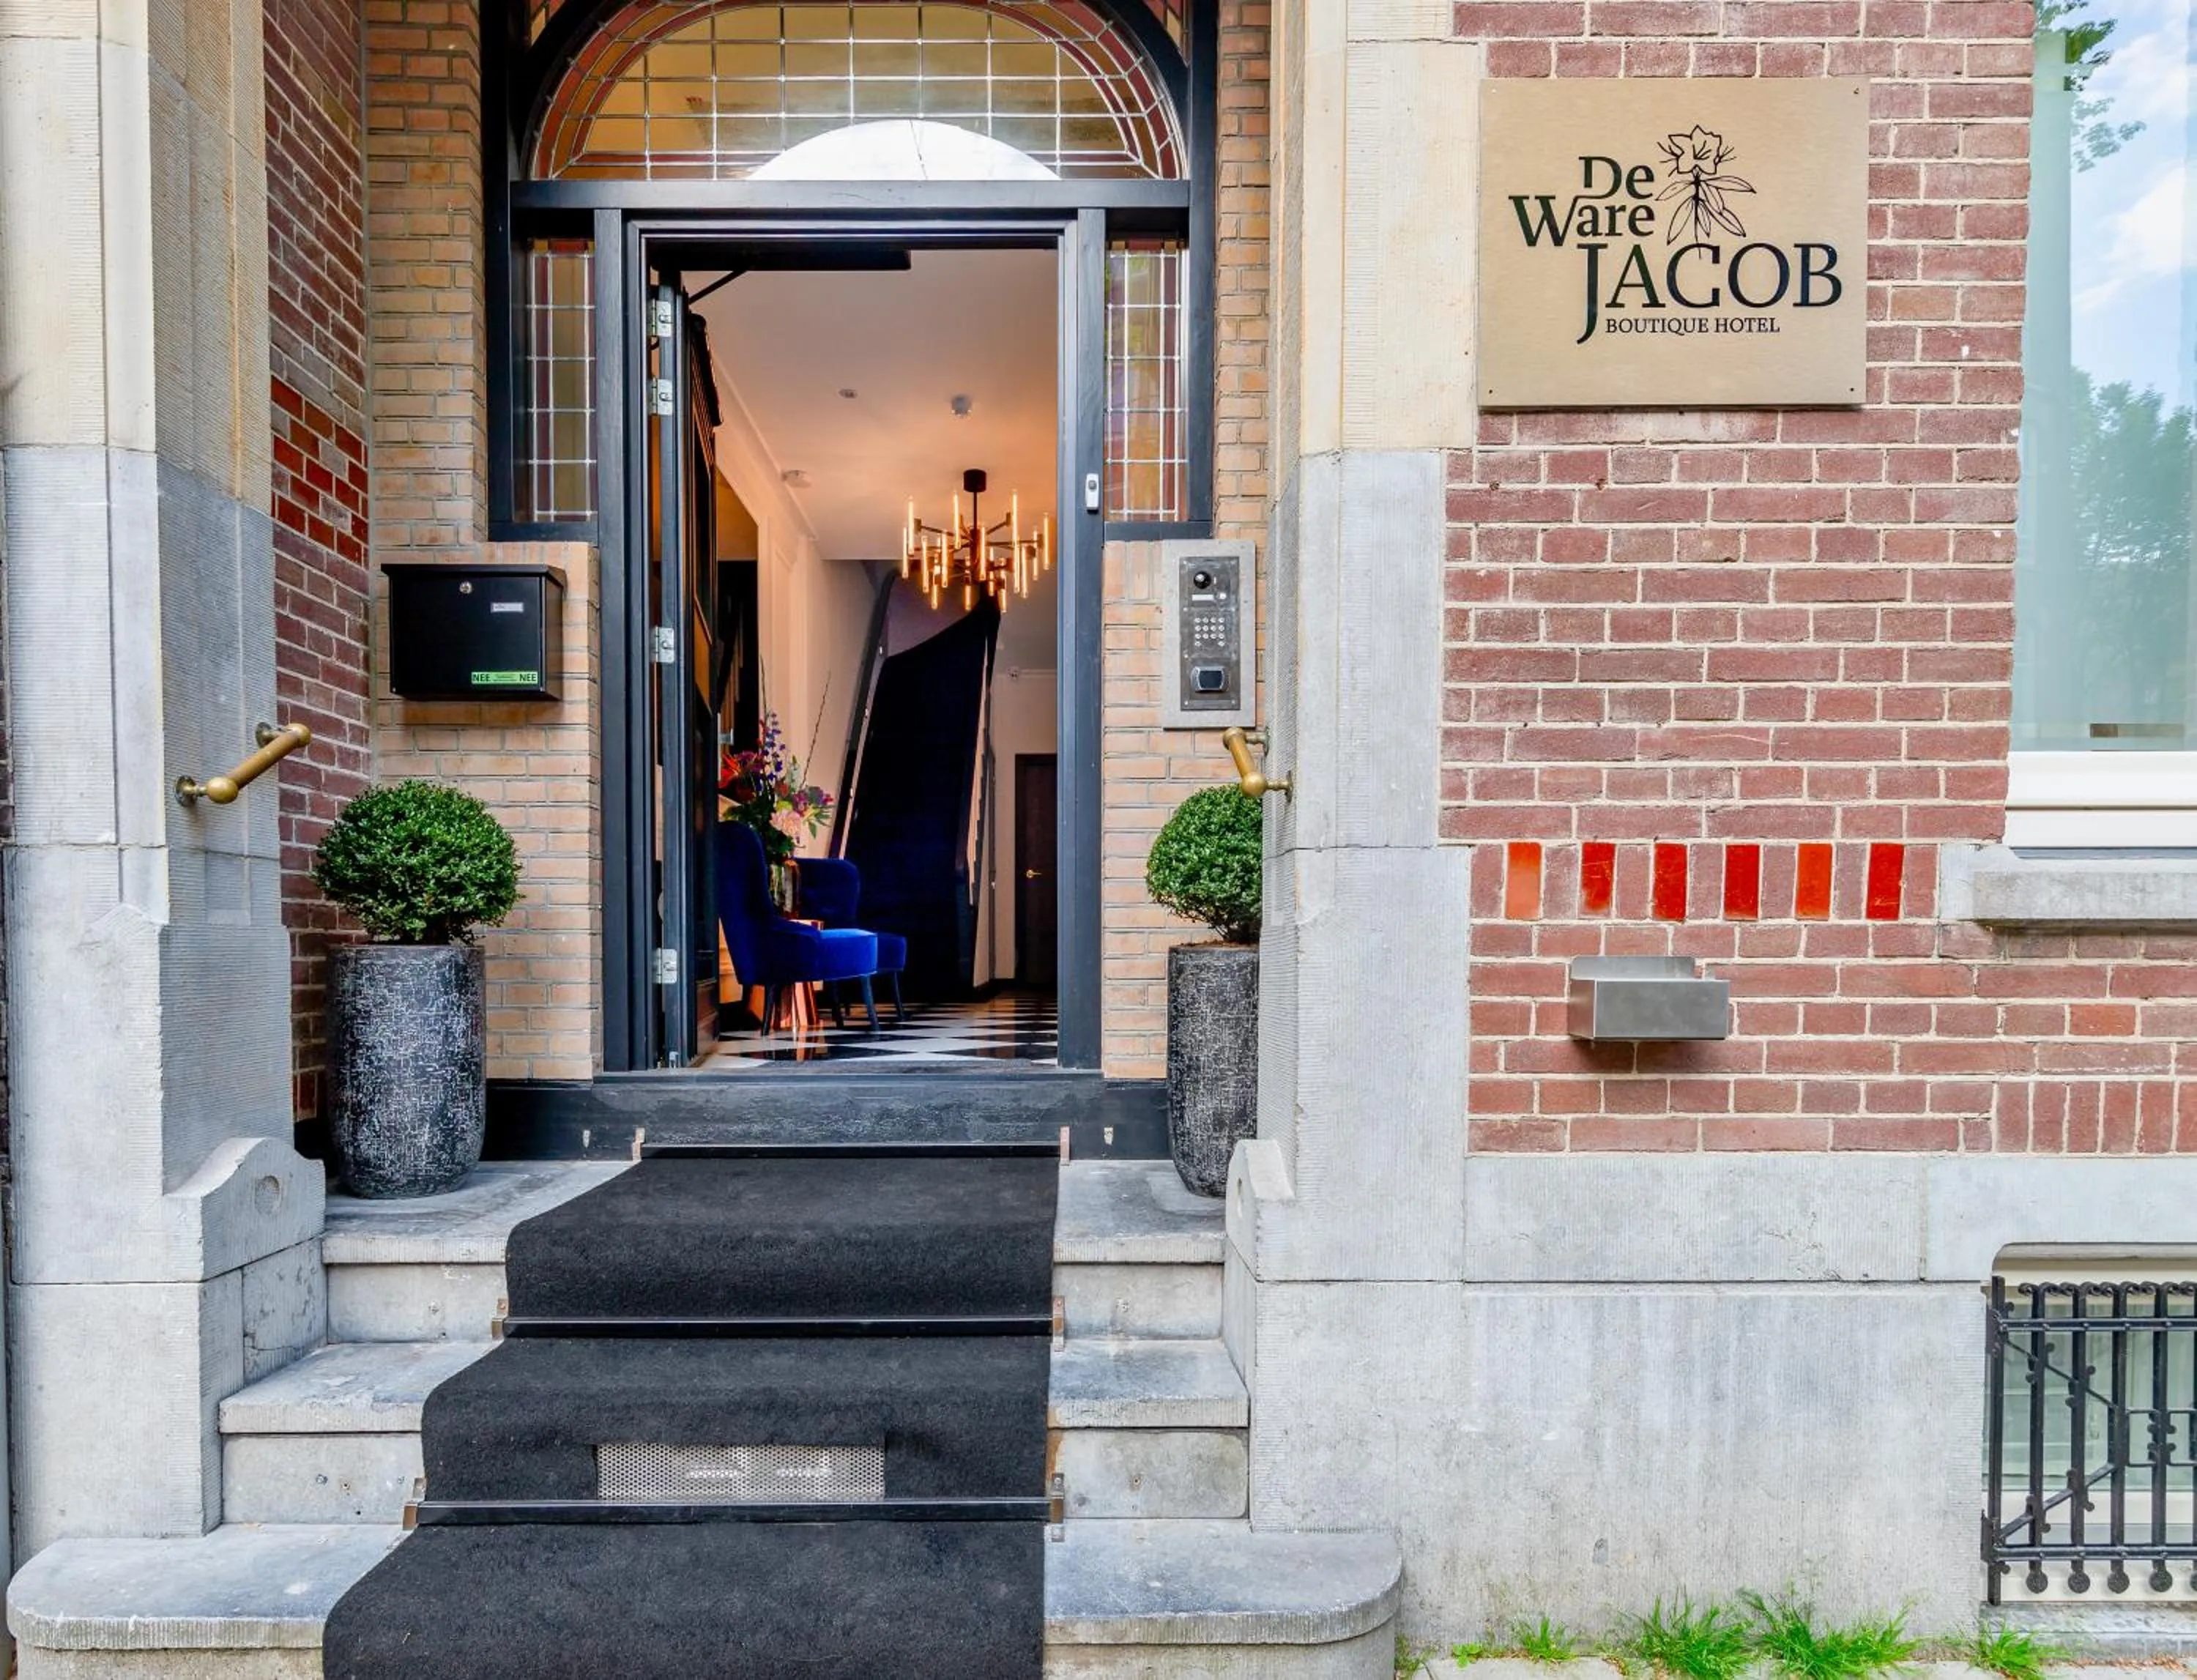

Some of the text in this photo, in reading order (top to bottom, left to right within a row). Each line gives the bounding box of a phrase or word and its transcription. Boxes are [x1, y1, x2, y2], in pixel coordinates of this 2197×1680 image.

[1578, 156, 1655, 200] De
[1509, 194, 1655, 247] Ware
[1576, 242, 1843, 345] JACOB
[1605, 317, 1780, 336] BOUTIQUE HOTEL
[472, 673, 491, 682] NEE
[519, 673, 536, 682] NEE
